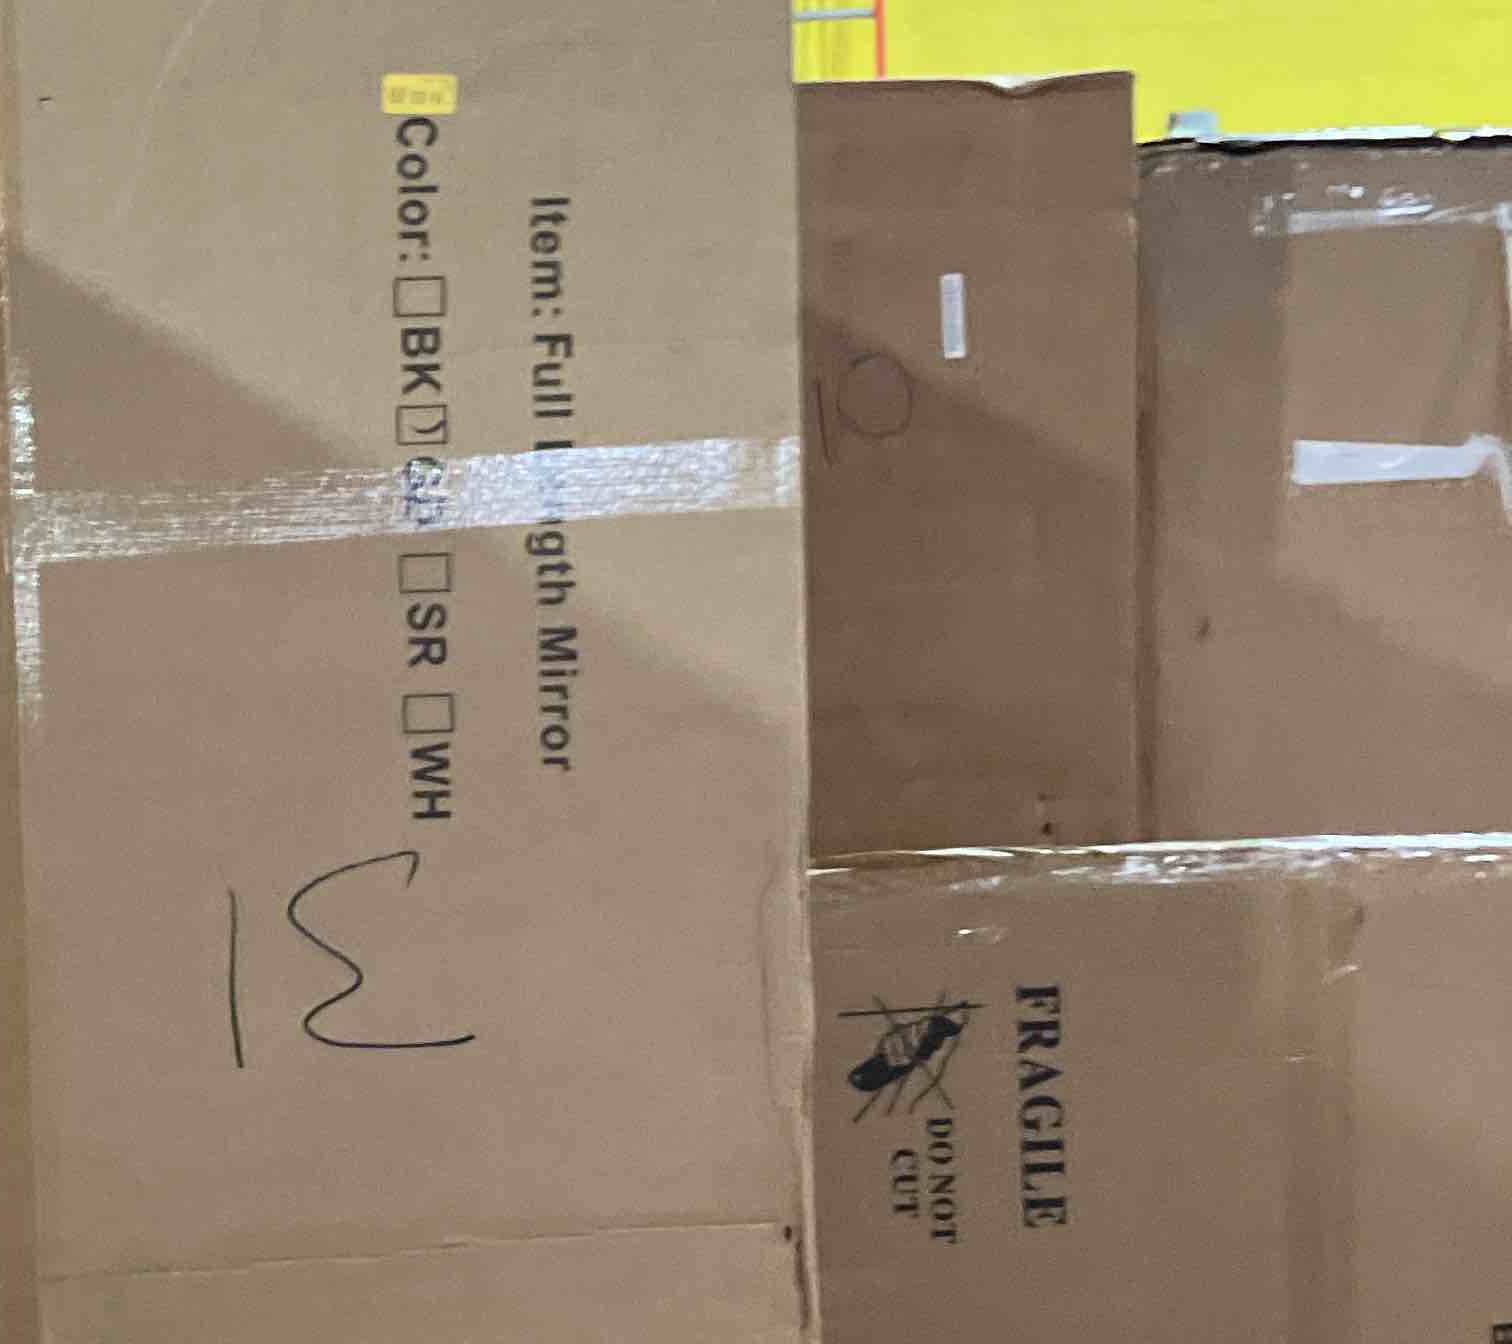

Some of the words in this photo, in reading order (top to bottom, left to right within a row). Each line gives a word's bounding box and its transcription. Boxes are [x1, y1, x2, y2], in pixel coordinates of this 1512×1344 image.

[396, 116, 439, 262] Color:
[527, 196, 570, 318] Item:
[400, 327, 444, 394] BK
[530, 334, 576, 420] Full
[407, 603, 448, 668] SR
[538, 626, 579, 773] Mirror
[410, 742, 453, 821] WH
[926, 1117, 954, 1164] DO
[1016, 984, 1069, 1231] FRAGILE
[891, 1148, 919, 1218] CUT
[929, 1174, 958, 1245] NOT
